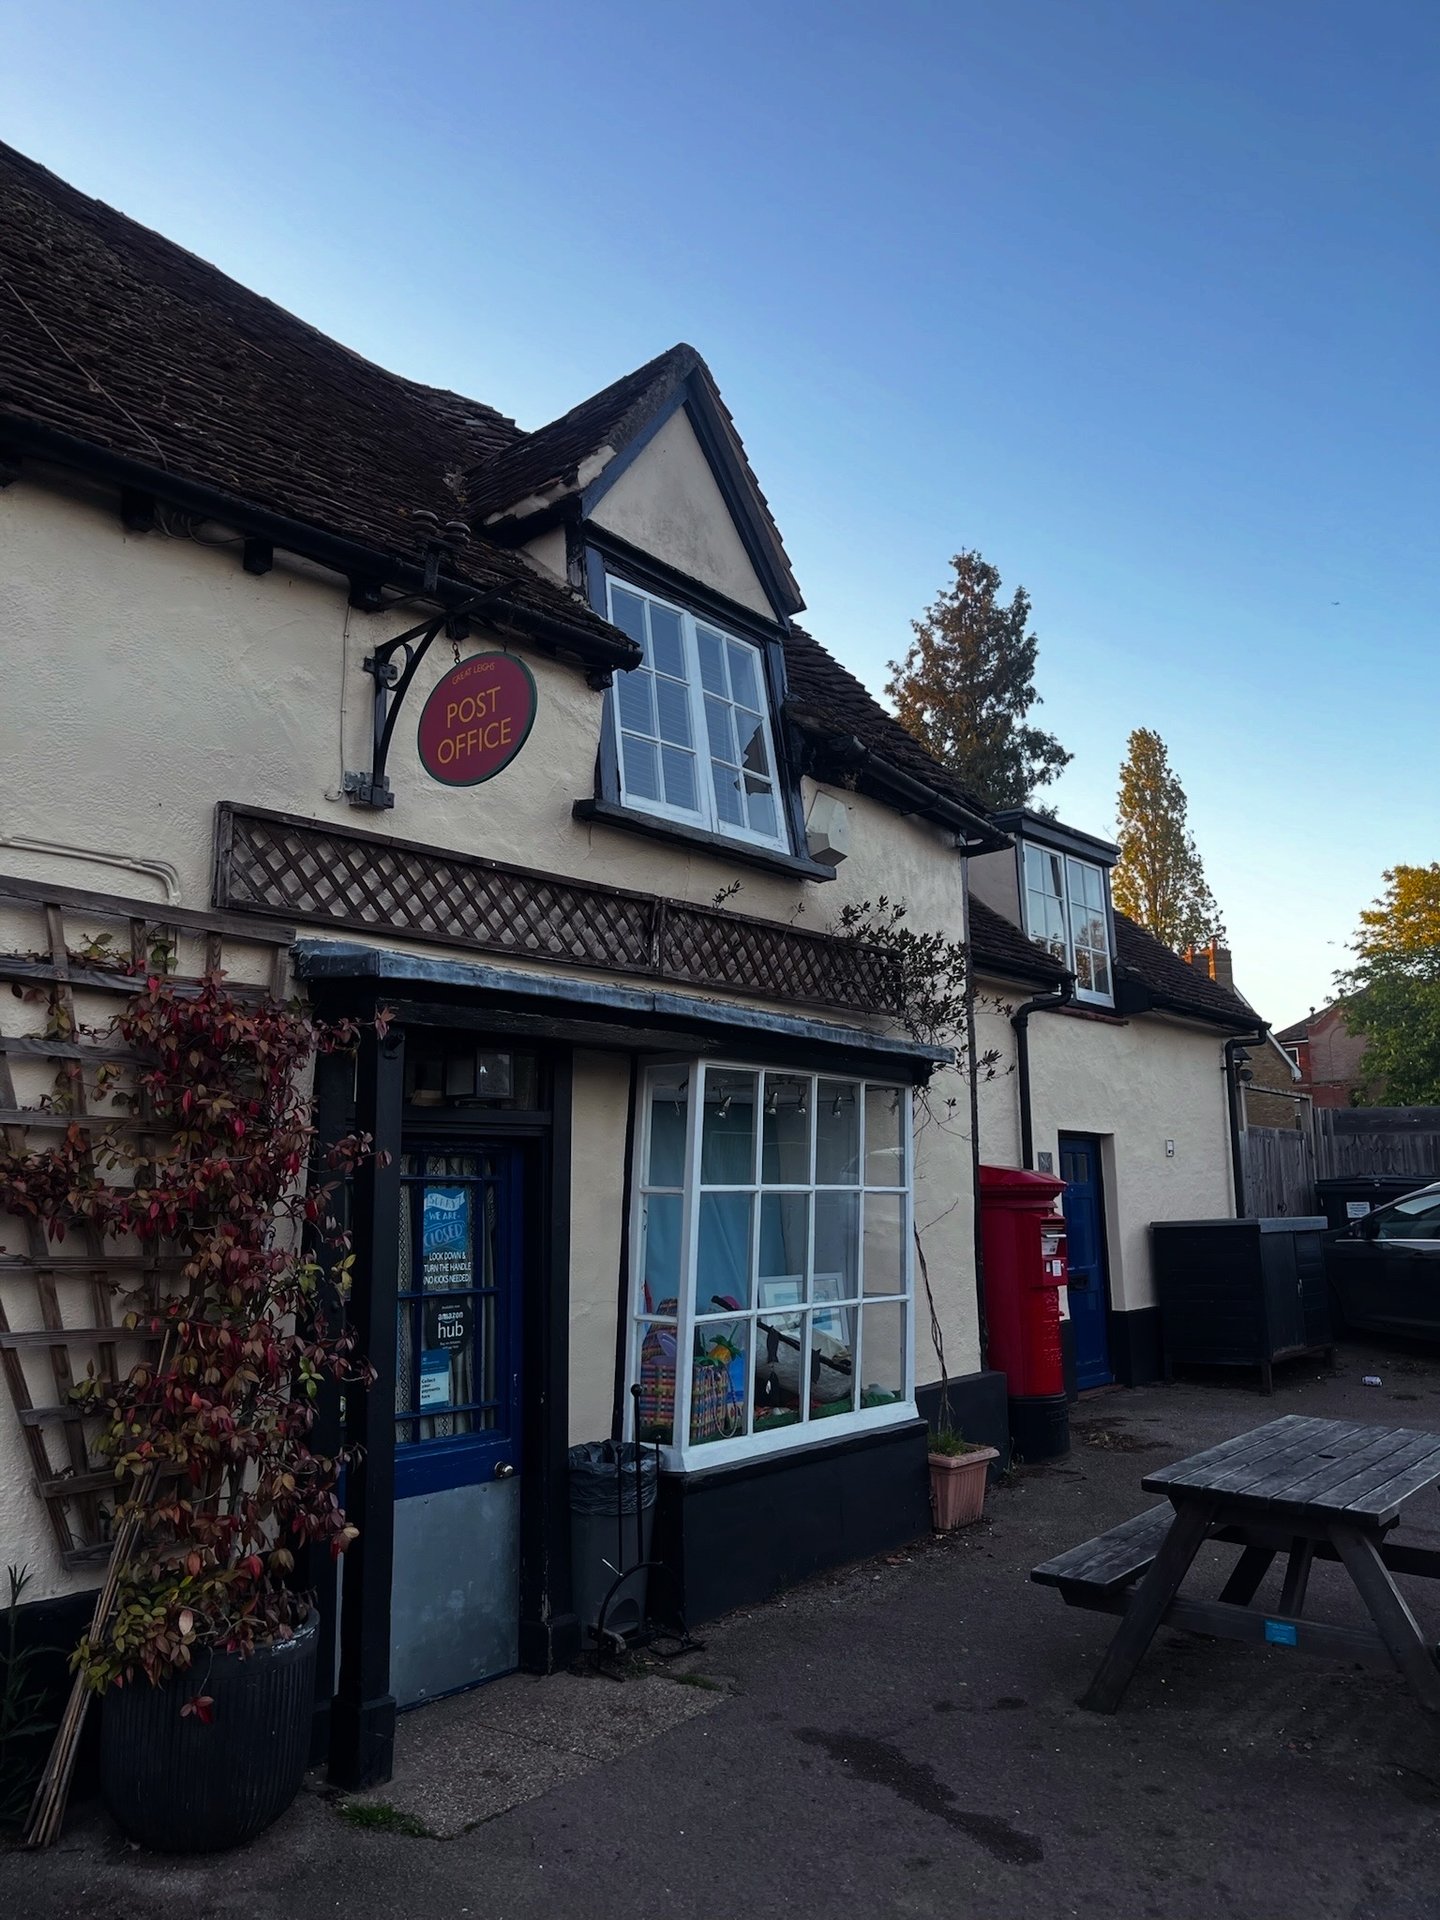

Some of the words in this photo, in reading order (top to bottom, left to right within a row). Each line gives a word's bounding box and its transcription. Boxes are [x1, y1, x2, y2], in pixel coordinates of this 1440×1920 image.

[452, 668, 472, 685] GREAT
[473, 663, 495, 673] LEIGHS
[447, 686, 501, 729] POST
[437, 717, 512, 764] OFFICE
[429, 1211, 440, 1220] WE
[442, 1211, 457, 1220] ARE
[424, 1224, 463, 1247] CLOSED
[429, 1252, 444, 1261] LOOK
[444, 1251, 461, 1261] DOWN
[462, 1251, 466, 1260] &
[424, 1264, 438, 1272] TURN
[439, 1263, 449, 1272] THE
[450, 1261, 472, 1271] HANDLE
[434, 1274, 449, 1284] KICKS
[437, 1311, 464, 1321] amazon
[437, 1320, 464, 1339] hub
